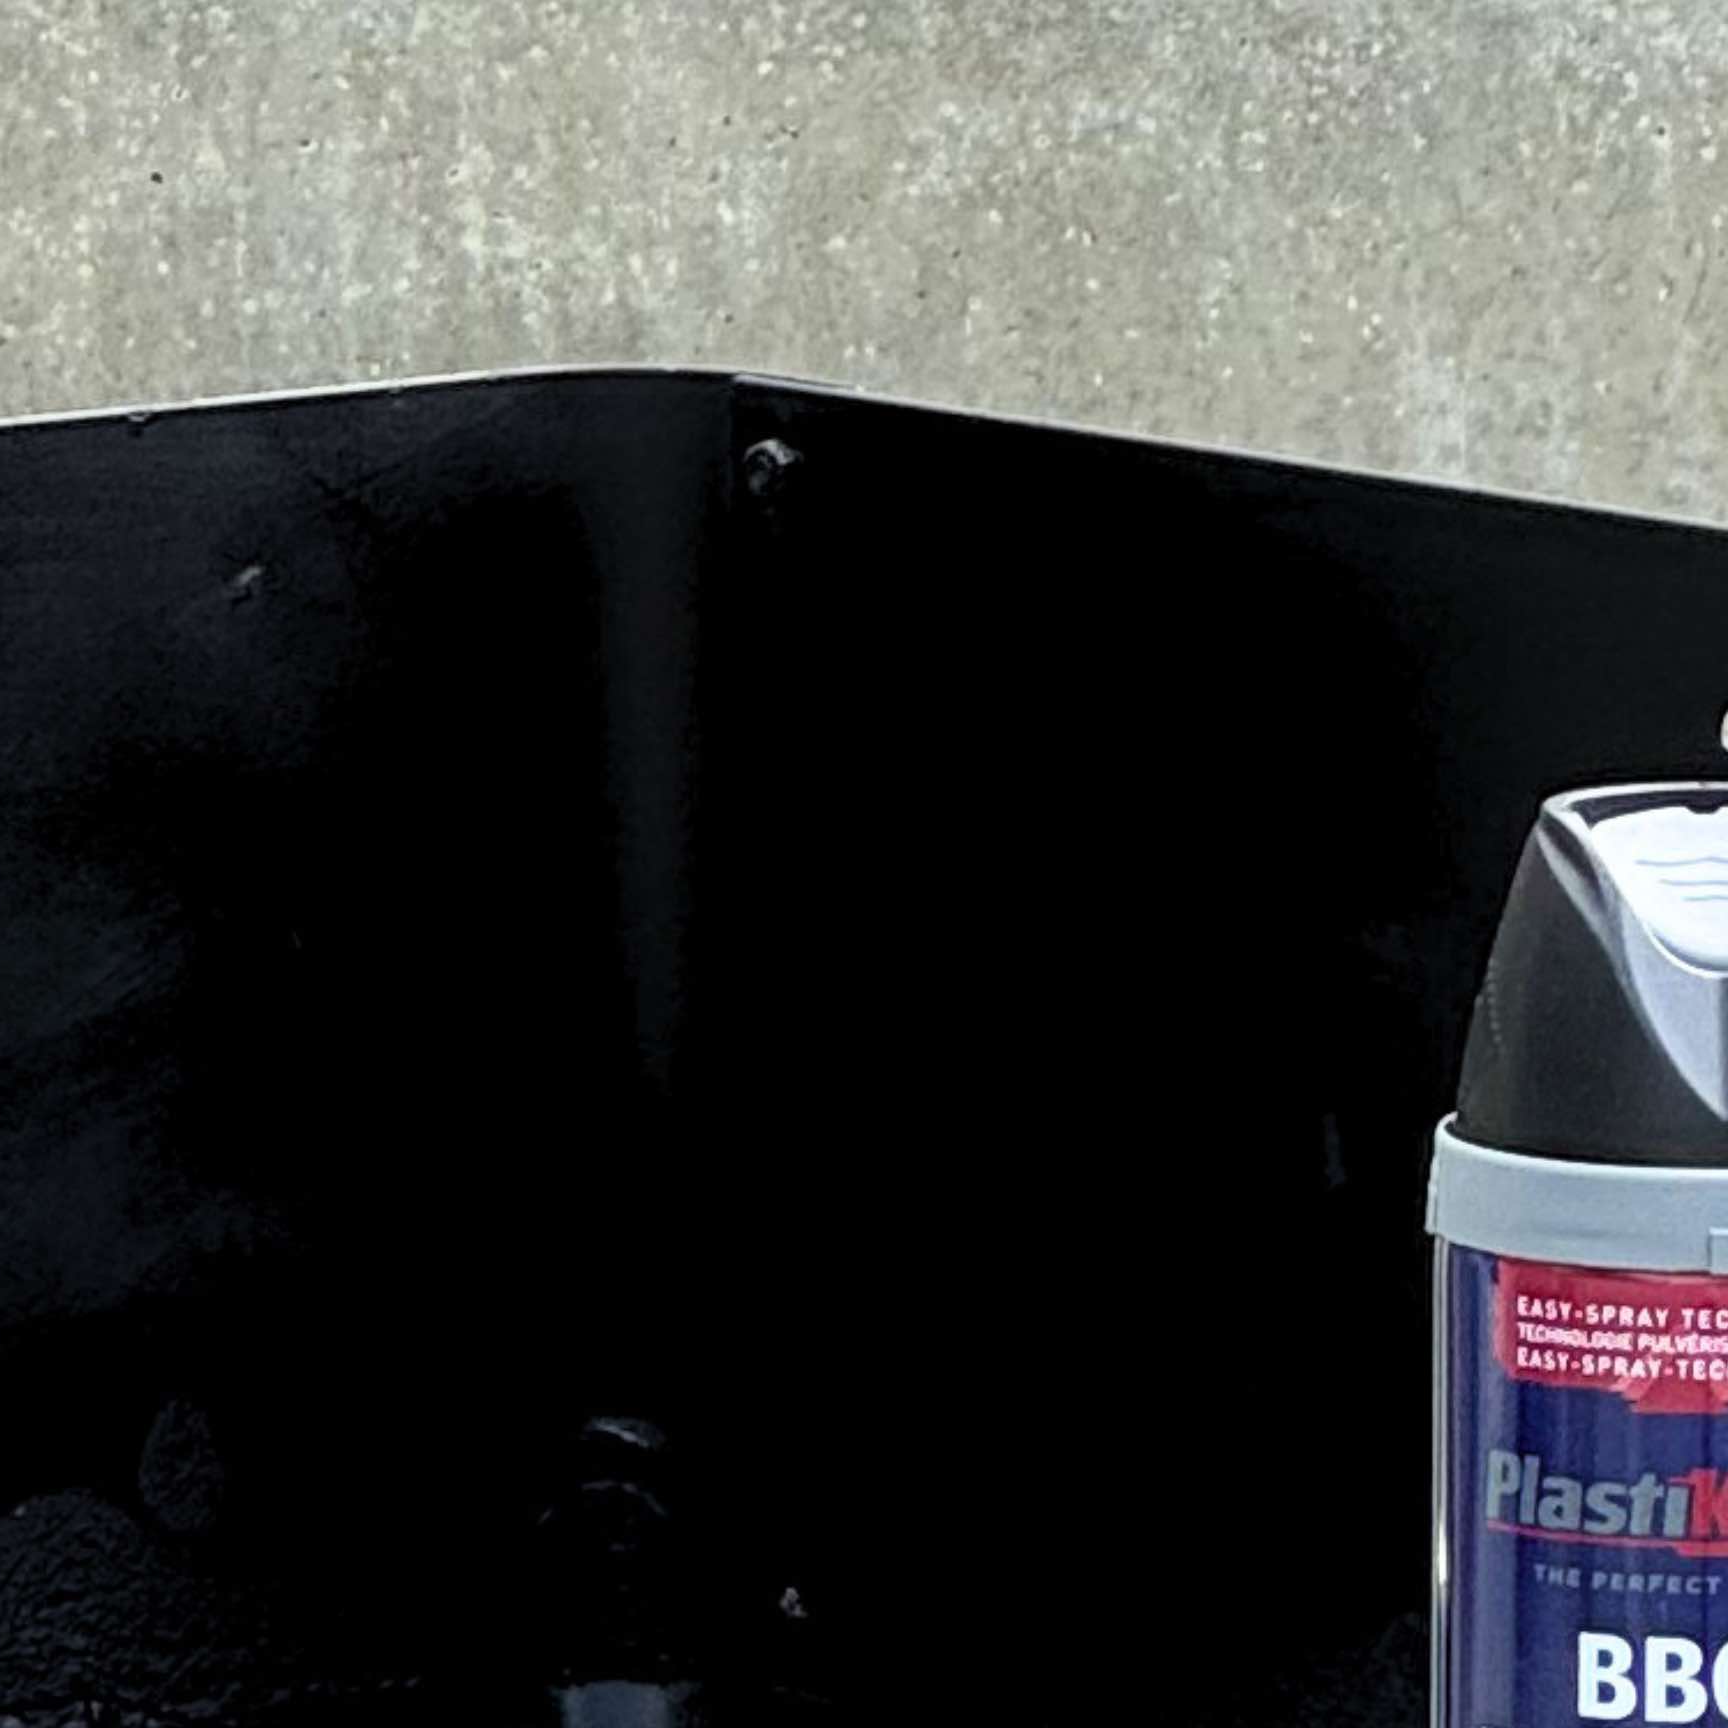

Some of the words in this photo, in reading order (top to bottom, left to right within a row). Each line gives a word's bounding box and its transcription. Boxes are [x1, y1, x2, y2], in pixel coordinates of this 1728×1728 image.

[1516, 1295, 1670, 1329] EASY-SPRAY
[1533, 1563, 1581, 1588] THE
[1591, 1568, 1722, 1596] PERFECT
